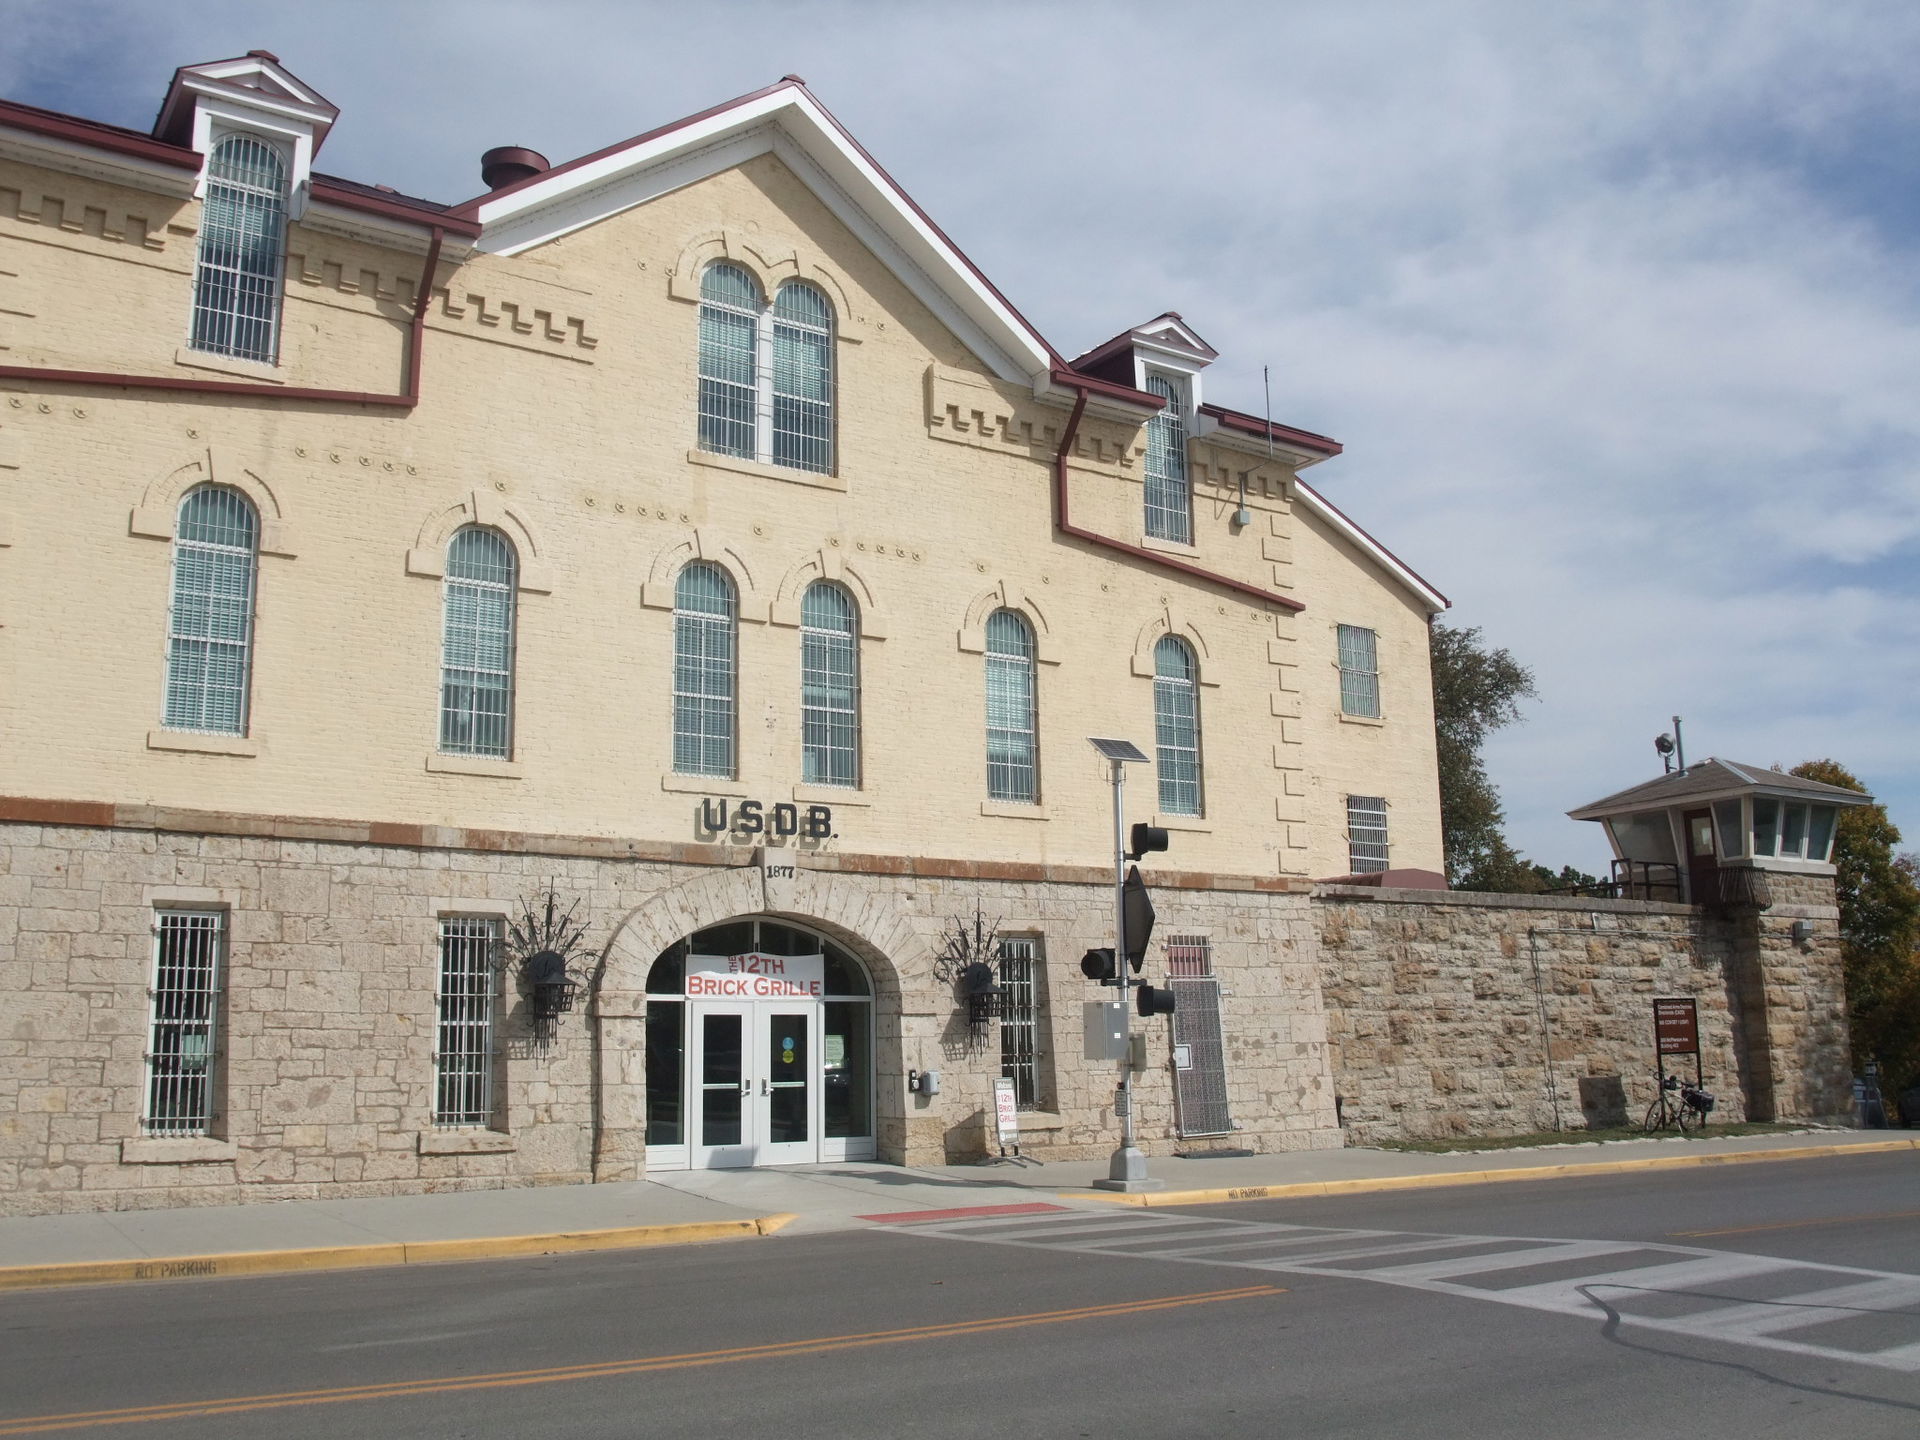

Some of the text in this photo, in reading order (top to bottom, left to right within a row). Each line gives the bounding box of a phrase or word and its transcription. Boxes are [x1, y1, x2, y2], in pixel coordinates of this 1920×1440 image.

[766, 865, 795, 879] 1877
[728, 955, 785, 974] THE 12TH
[688, 976, 821, 996] BRICK GRILLE
[161, 1260, 217, 1279] PARKING
